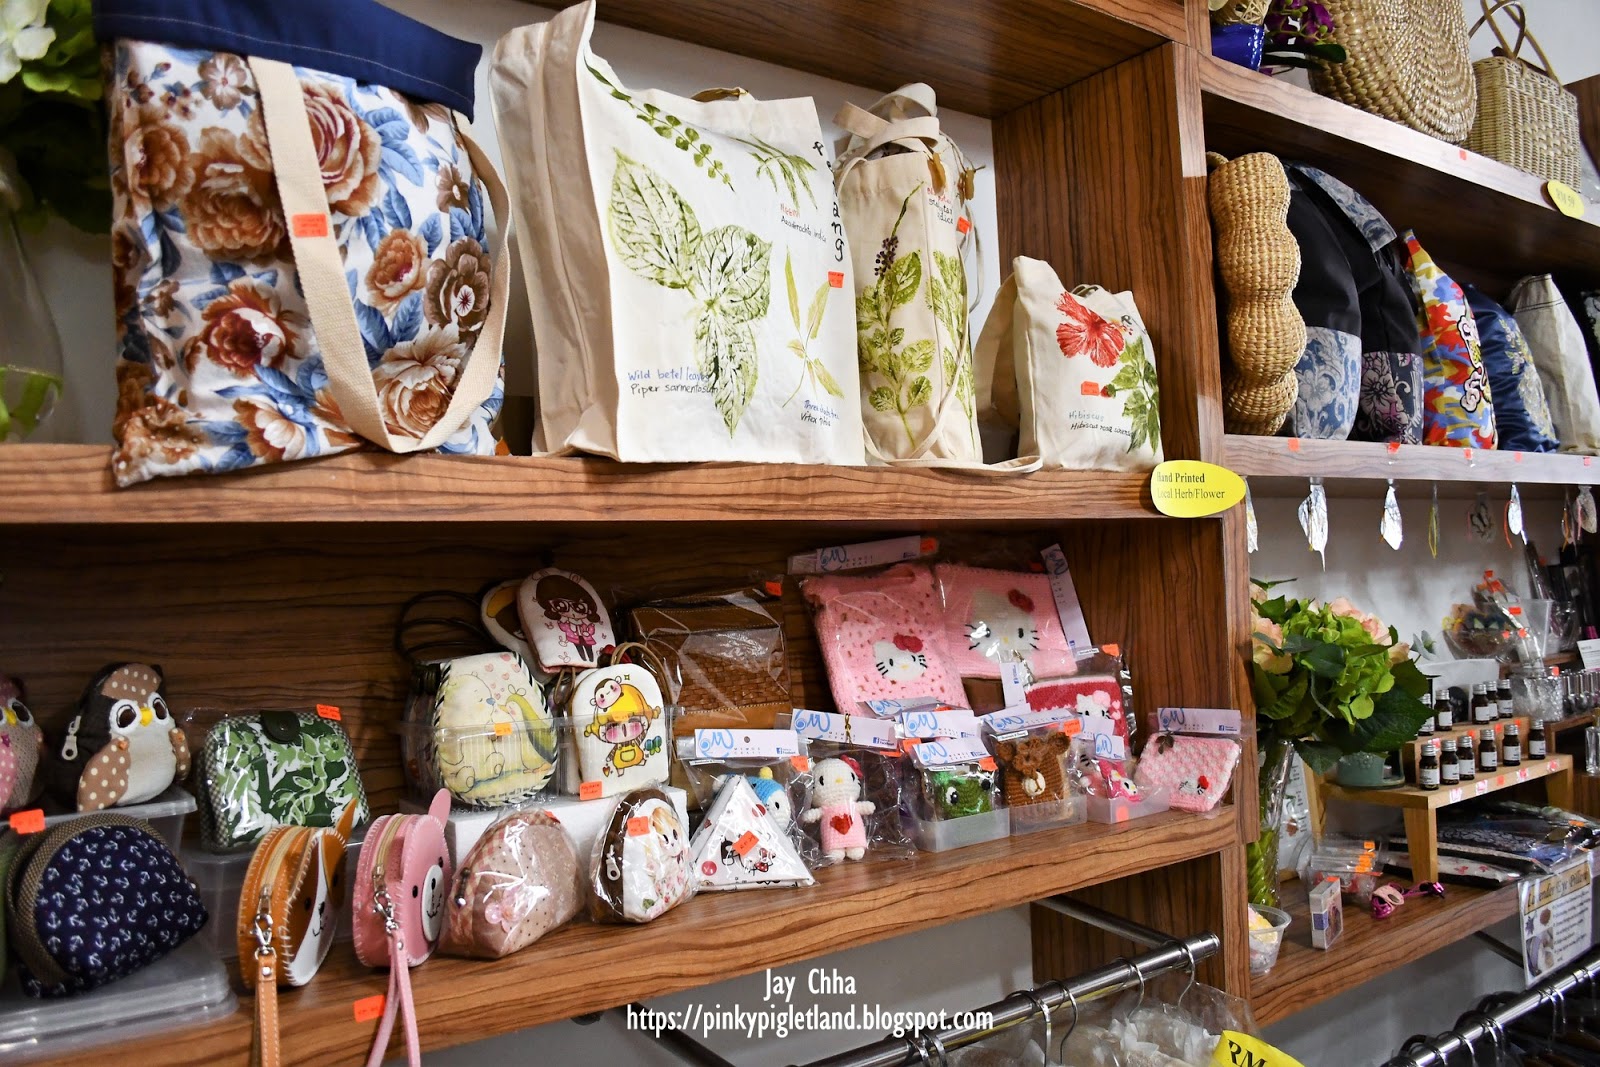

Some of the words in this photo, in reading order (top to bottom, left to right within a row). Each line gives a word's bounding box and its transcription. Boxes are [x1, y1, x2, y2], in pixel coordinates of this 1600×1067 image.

[628, 369, 651, 381] Wild
[657, 367, 683, 380] betel
[630, 383, 660, 398] Piper
[1068, 410, 1105, 422] Hibiscus
[1070, 420, 1099, 430] Hibiscus
[1156, 471, 1173, 483] Hand
[1175, 472, 1206, 483] Printed
[1157, 487, 1173, 499] Local
[1174, 487, 1226, 499] Herb/Flower
[1227, 1038, 1268, 1067] RM
